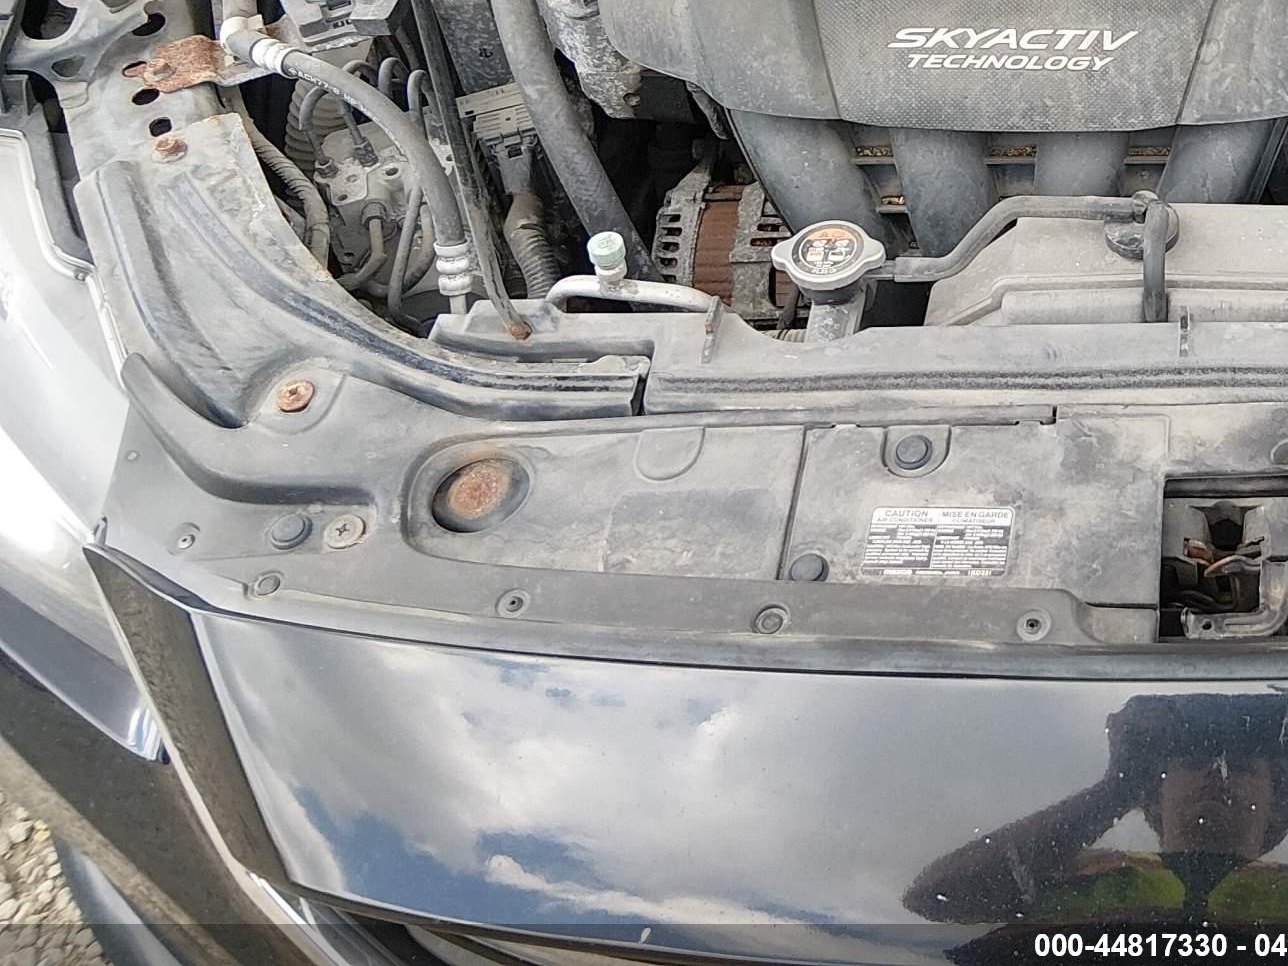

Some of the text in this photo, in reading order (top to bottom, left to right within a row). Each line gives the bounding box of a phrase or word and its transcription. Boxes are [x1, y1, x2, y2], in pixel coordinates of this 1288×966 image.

[888, 27, 1138, 51] SKYACTIV
[907, 53, 1115, 71] TECHNOLOGY
[885, 509, 929, 518] CAUTION
[978, 511, 1009, 519] GARDE
